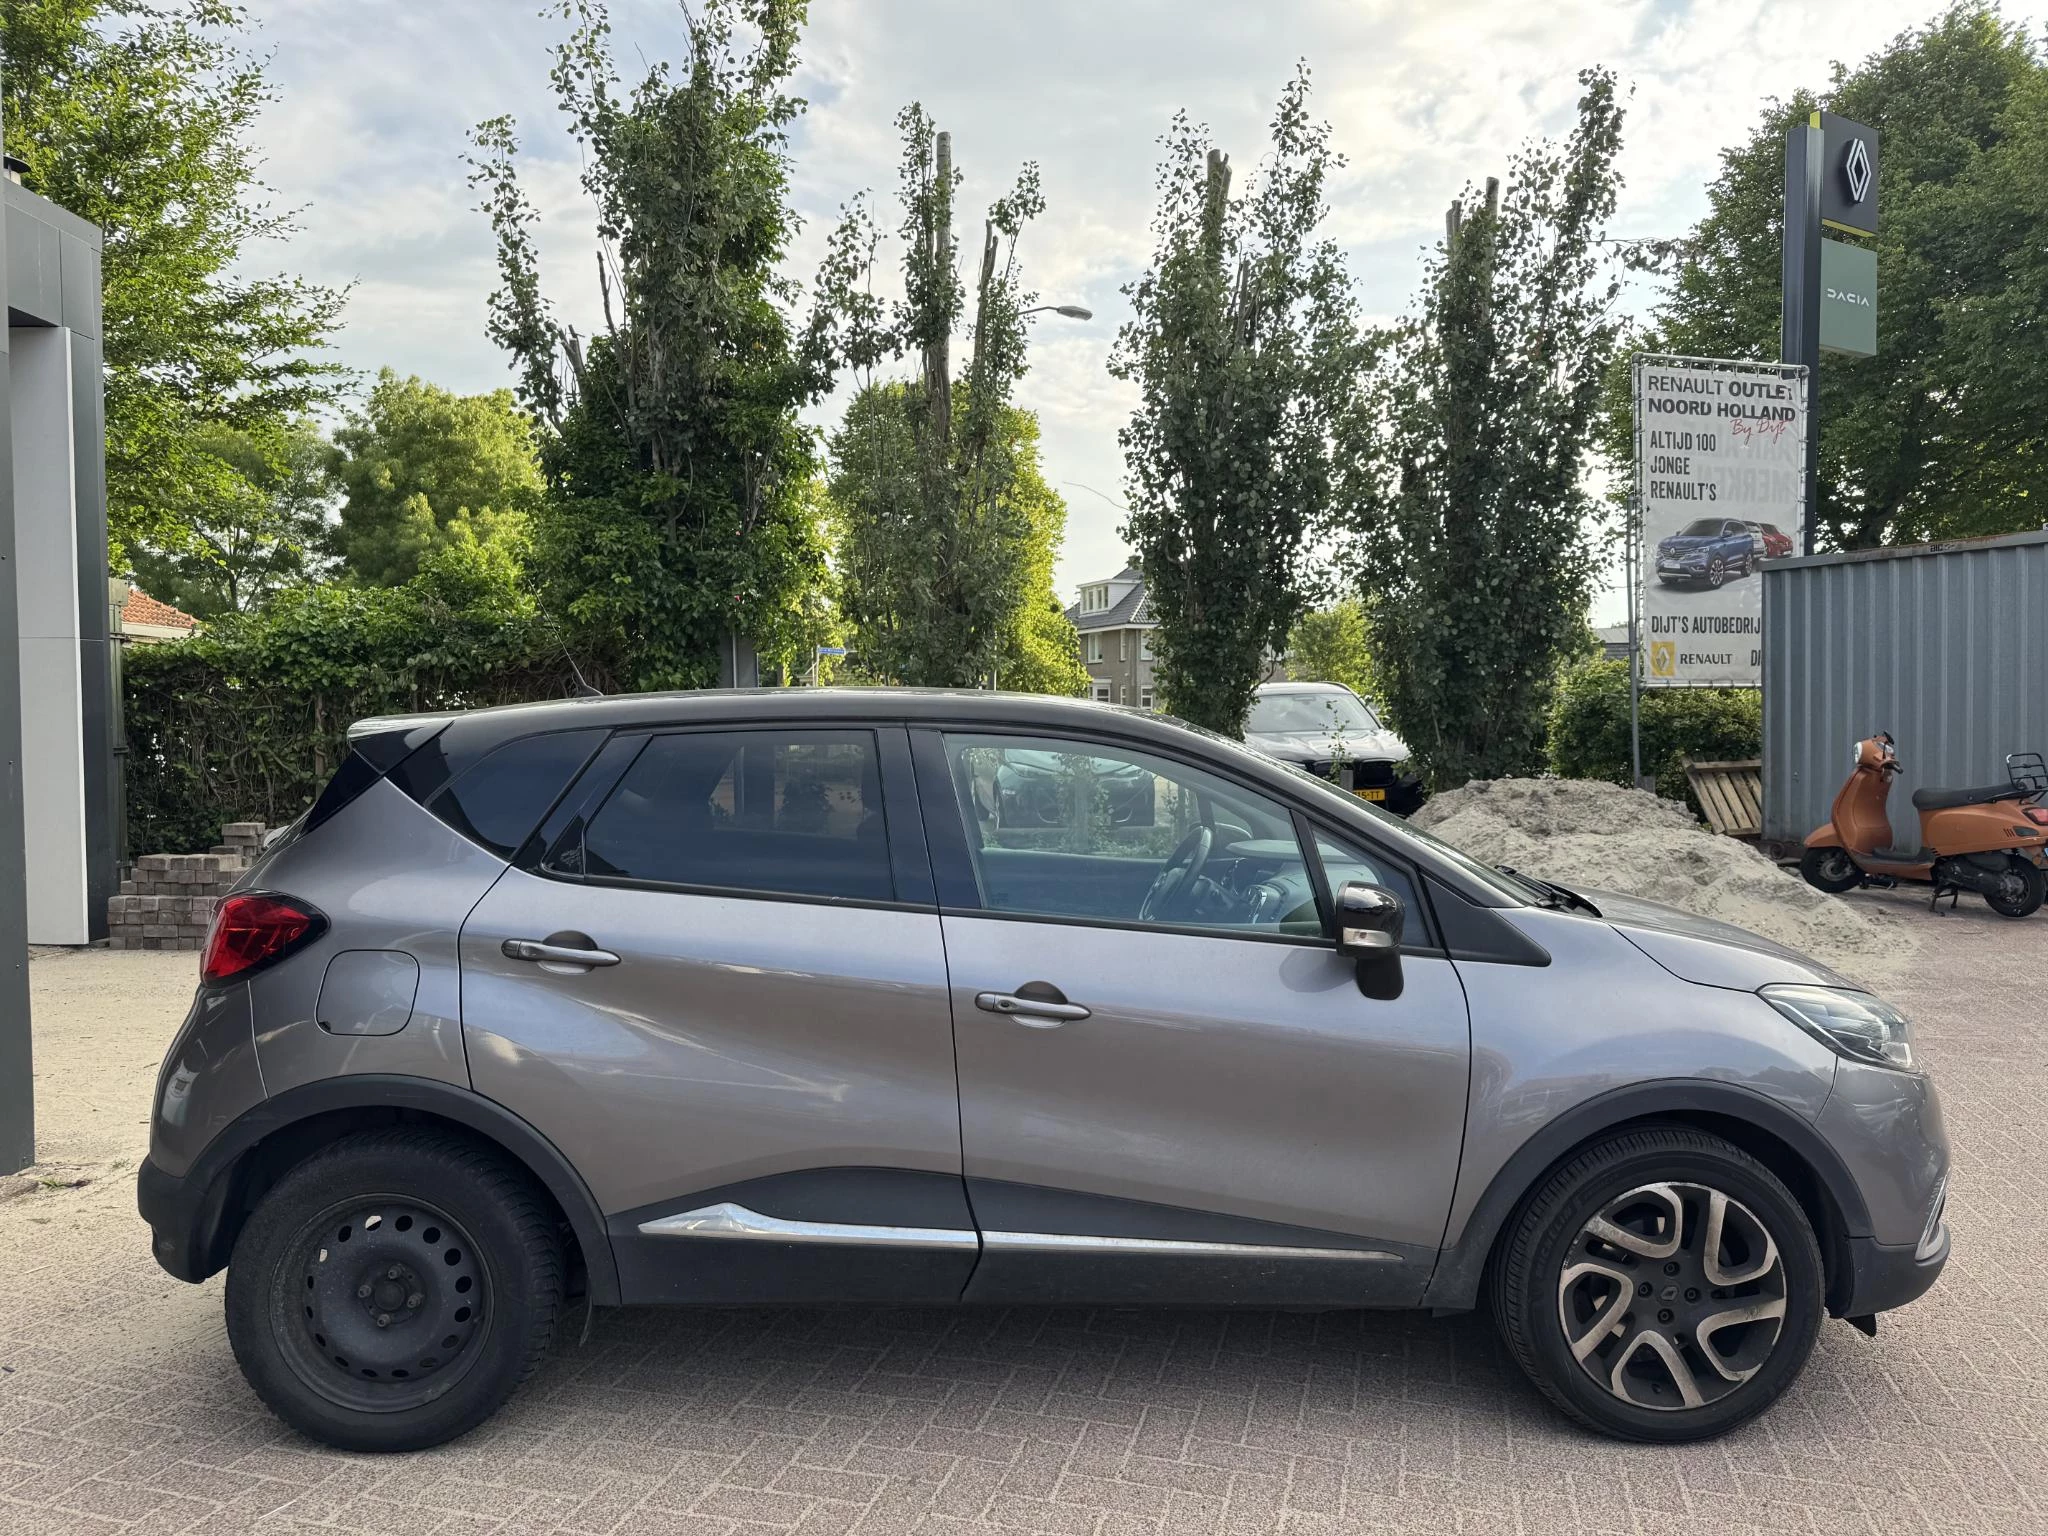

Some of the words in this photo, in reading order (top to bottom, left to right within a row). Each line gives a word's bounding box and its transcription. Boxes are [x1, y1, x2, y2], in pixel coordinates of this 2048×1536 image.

[1827, 288, 1870, 306] DACIA
[1648, 375, 1724, 395] RENAULT
[1648, 398, 1712, 416] NOORD
[1717, 402, 1796, 421] HOLLAND
[1650, 430, 1692, 450] ALTIJD
[1696, 433, 1716, 451] 100
[1730, 419, 1752, 445] By
[1650, 455, 1690, 475] JONGE
[1650, 480, 1717, 501] RENAULT'S
[1651, 615, 1689, 634] DIJT'S
[1692, 616, 1761, 635] AUTOBEDRIJ
[1680, 653, 1733, 665] RENAULT
[1751, 650, 1761, 666] DI
